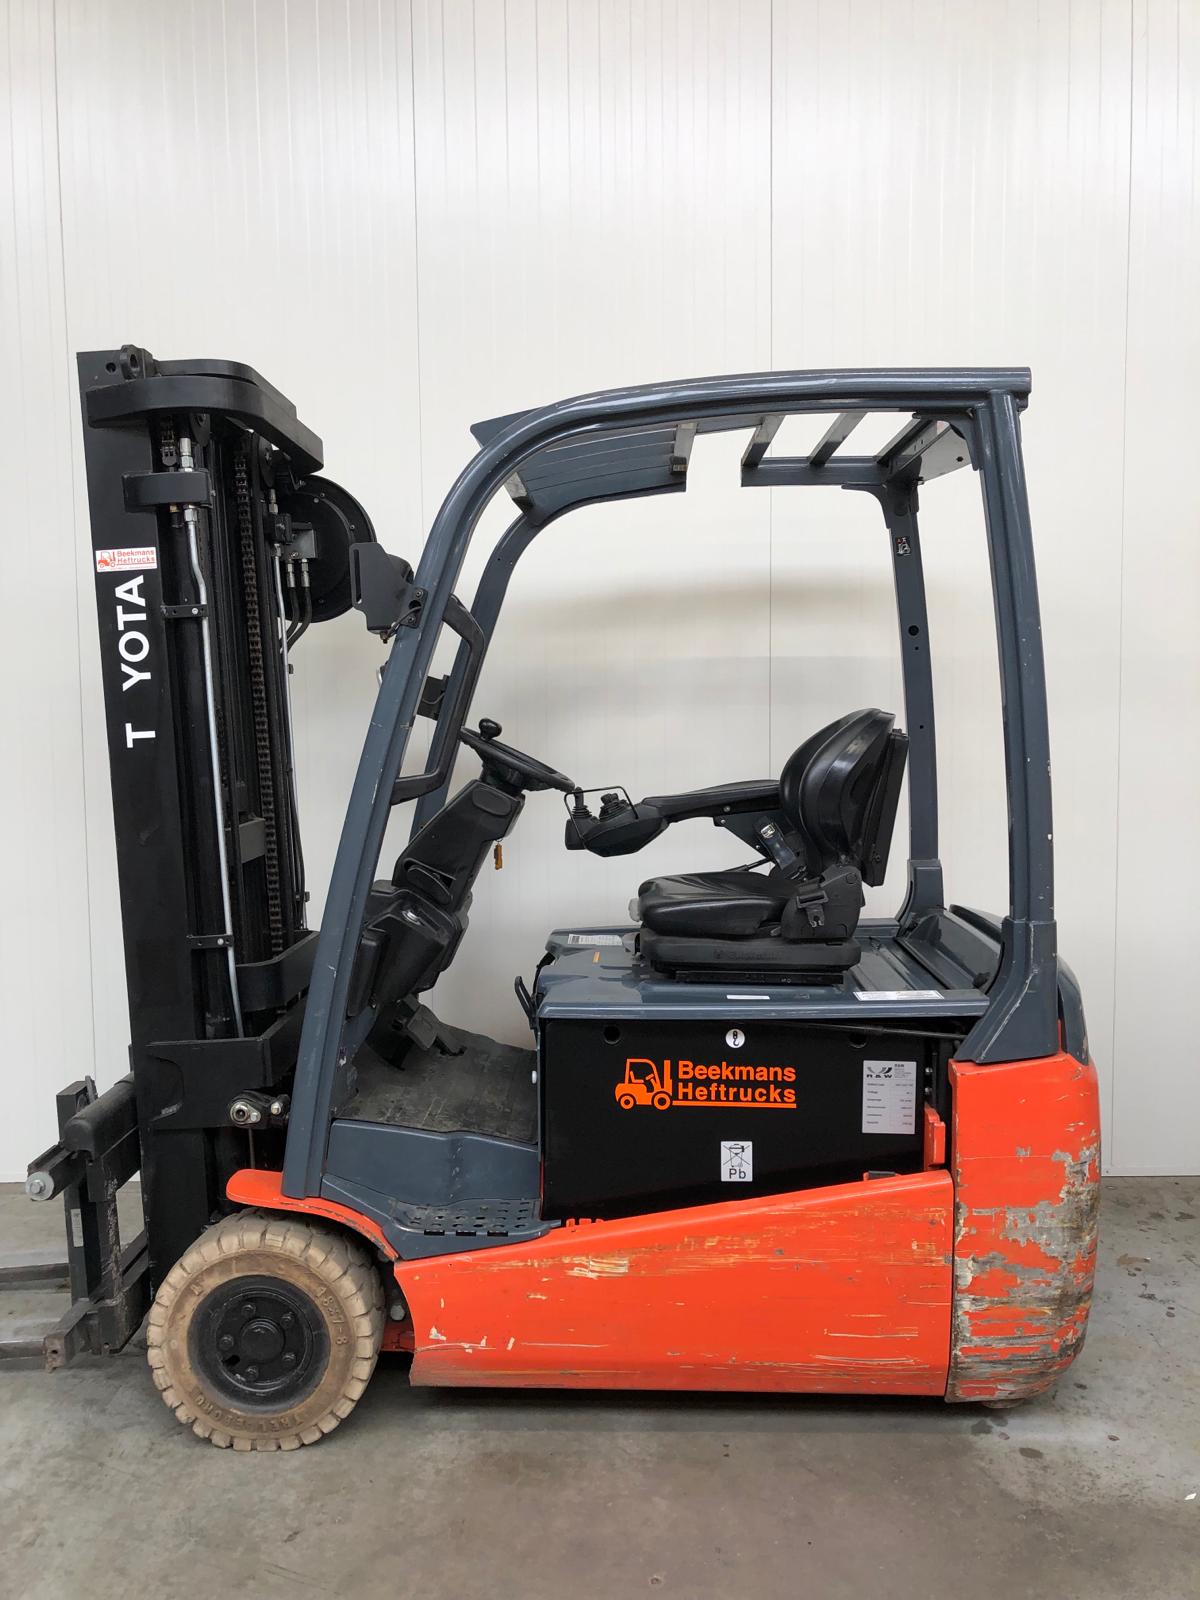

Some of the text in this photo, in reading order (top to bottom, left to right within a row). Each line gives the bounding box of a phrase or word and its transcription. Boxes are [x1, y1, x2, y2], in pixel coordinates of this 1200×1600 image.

[678, 1060, 796, 1082] Beekmans
[678, 1082, 796, 1103] Heftrucks
[729, 1168, 746, 1179] Pb
